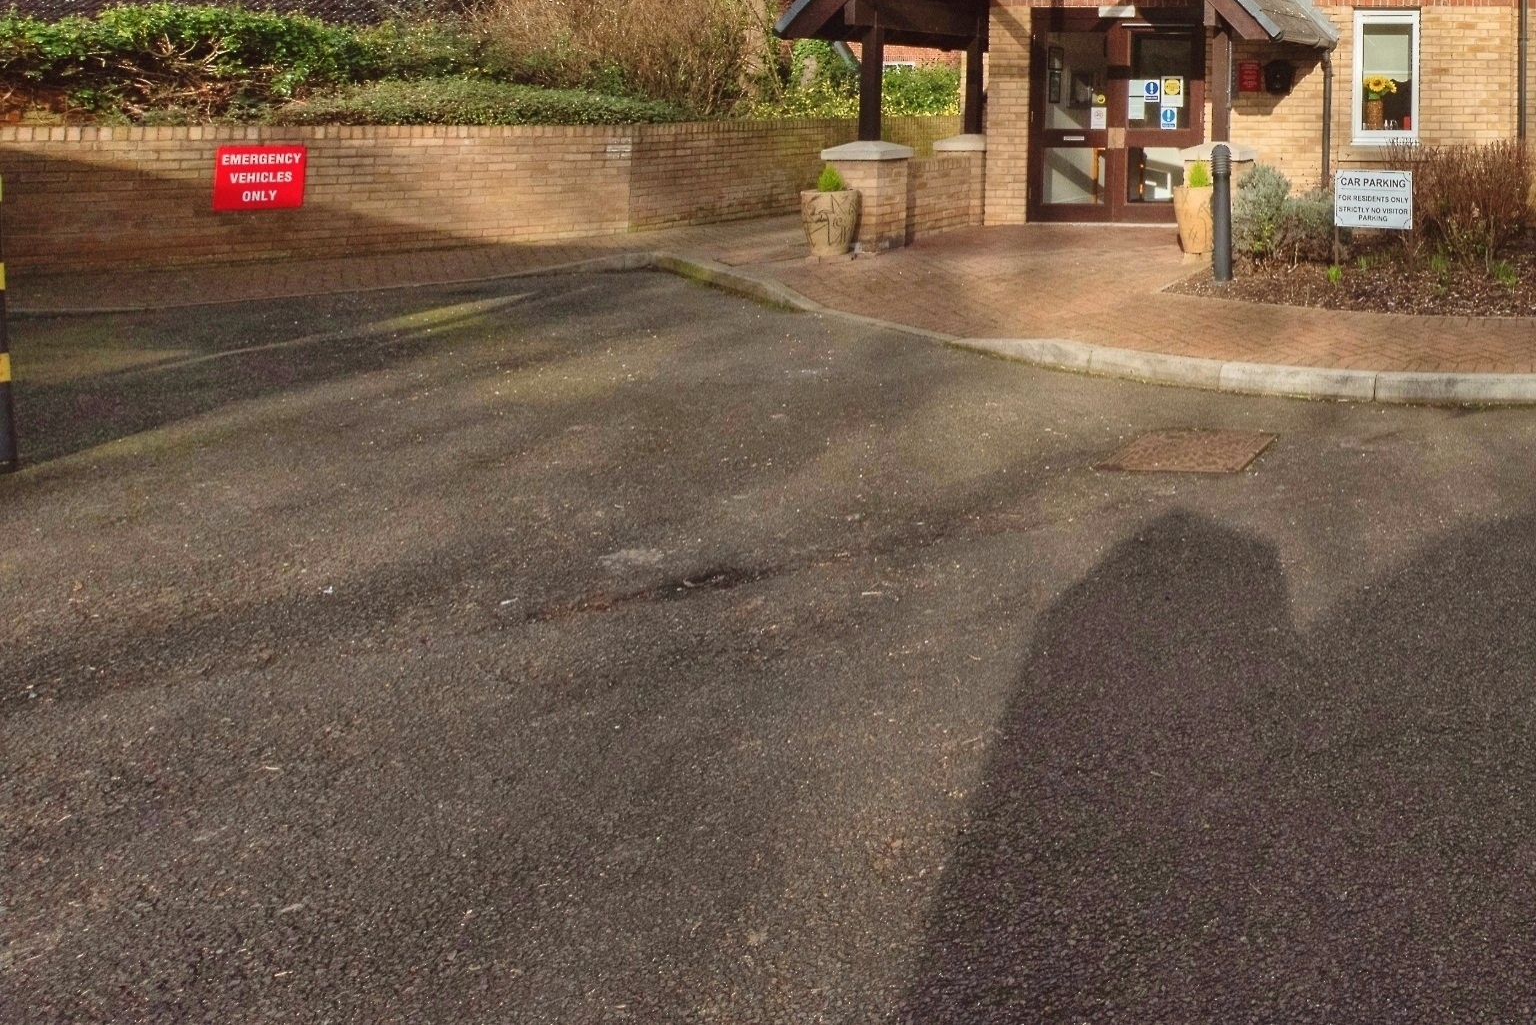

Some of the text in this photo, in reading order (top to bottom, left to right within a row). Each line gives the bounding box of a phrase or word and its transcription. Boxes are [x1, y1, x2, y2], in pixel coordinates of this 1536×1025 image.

[221, 152, 302, 166] EMERGENCY
[229, 171, 293, 184] VEHICLES
[1340, 177, 1406, 188] CAR PARKING
[242, 190, 277, 202] ONLY
[1353, 195, 1389, 203] RESIDENTS
[1382, 207, 1408, 215] VISITOR
